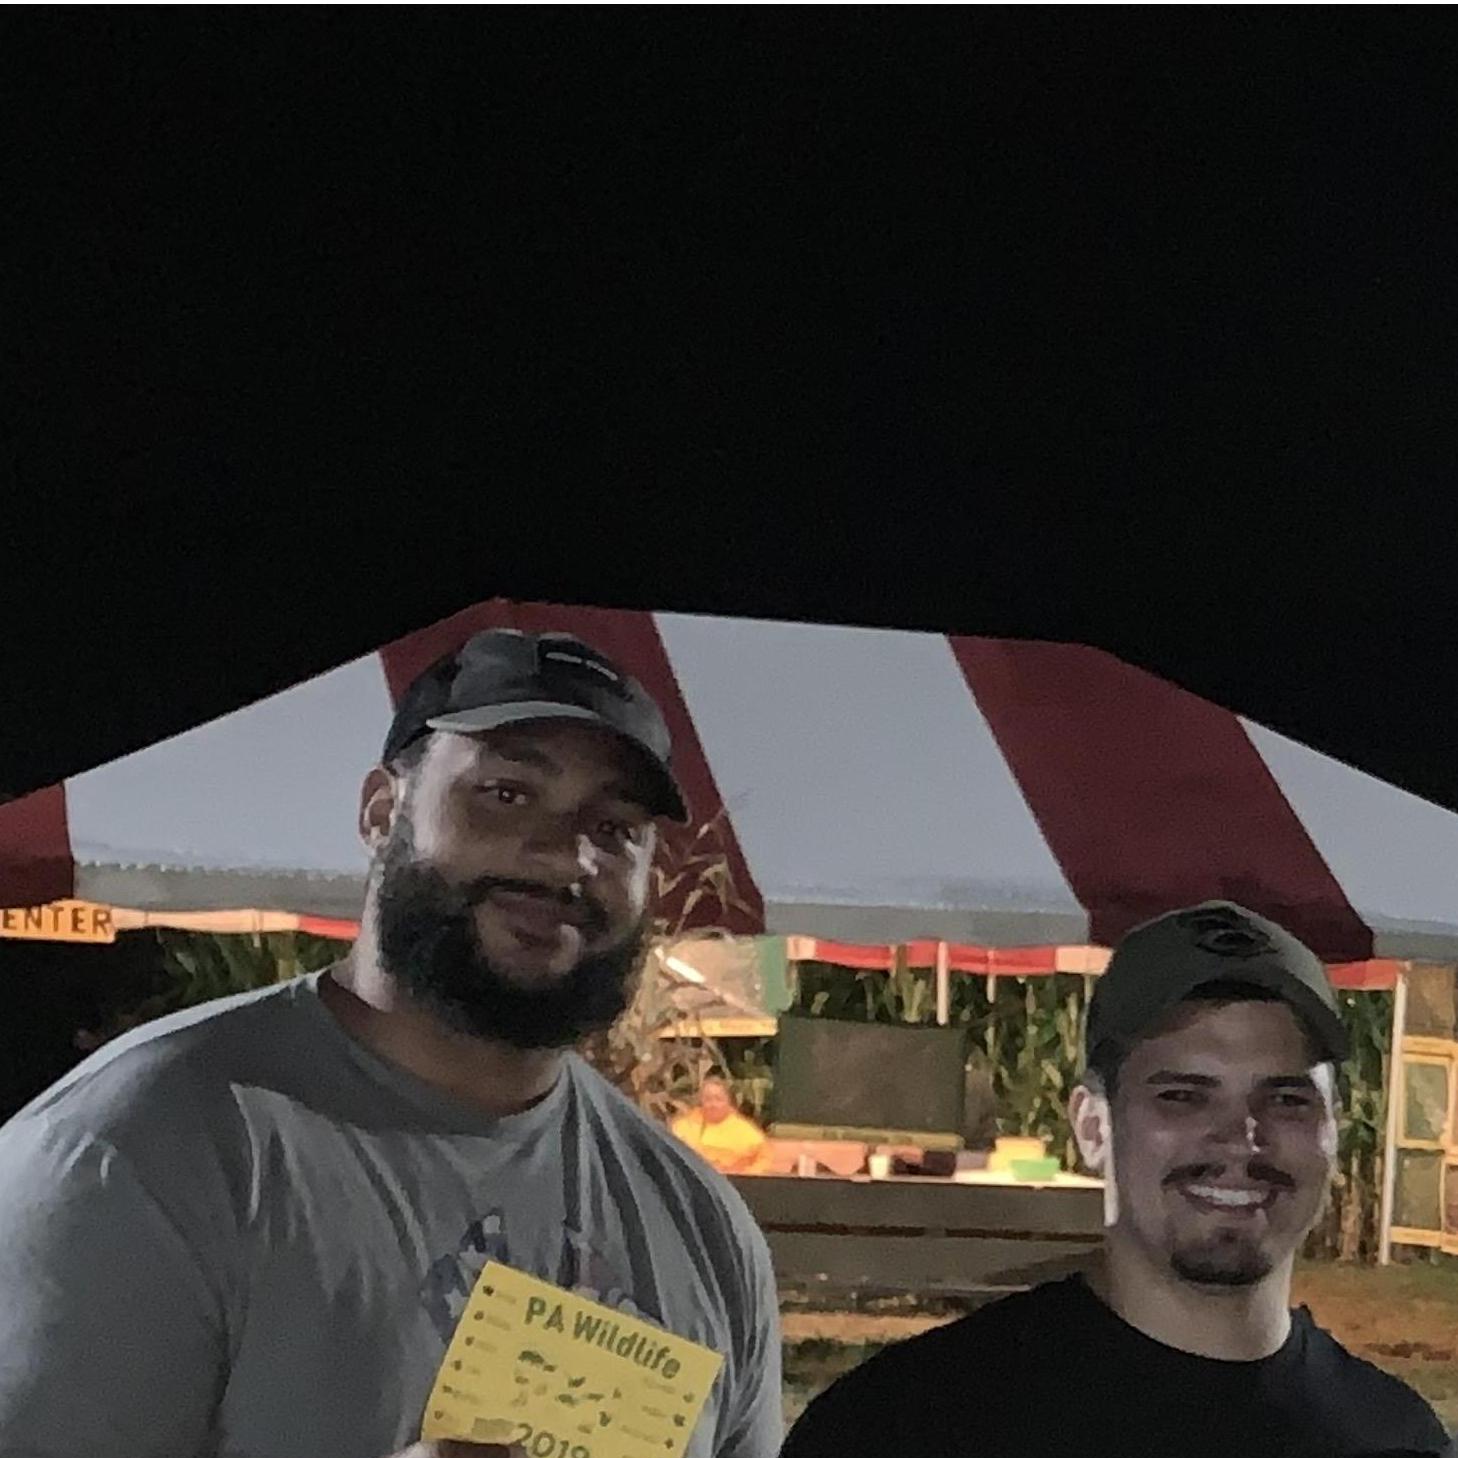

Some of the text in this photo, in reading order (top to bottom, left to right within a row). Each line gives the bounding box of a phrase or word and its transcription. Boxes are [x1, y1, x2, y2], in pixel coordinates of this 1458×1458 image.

[2, 905, 113, 936] ENTER
[523, 1296, 565, 1335] PA
[571, 1309, 682, 1380] Wildlife
